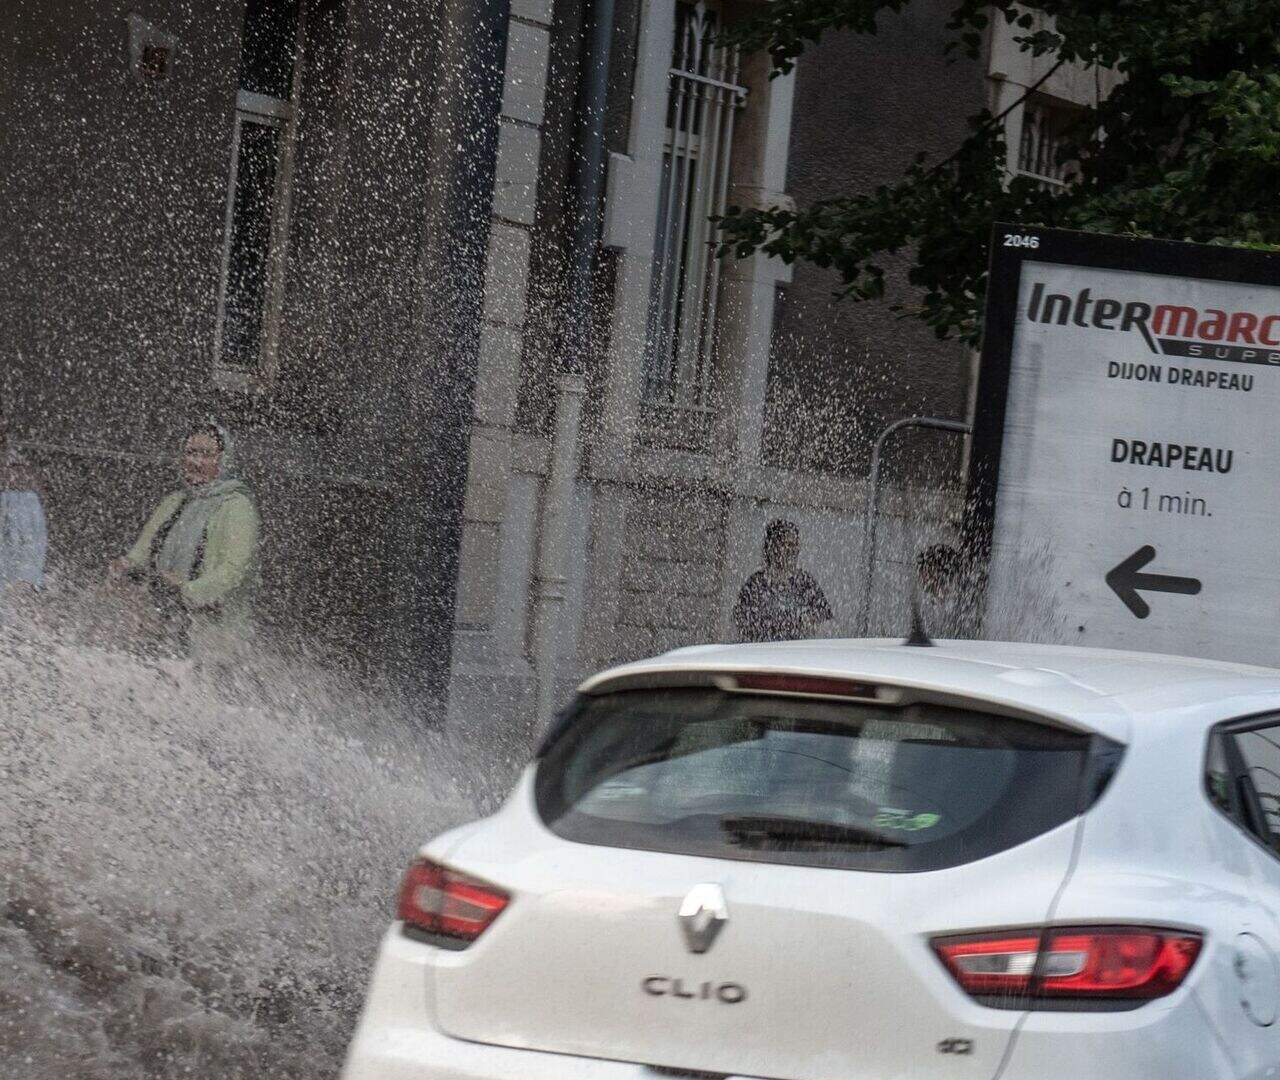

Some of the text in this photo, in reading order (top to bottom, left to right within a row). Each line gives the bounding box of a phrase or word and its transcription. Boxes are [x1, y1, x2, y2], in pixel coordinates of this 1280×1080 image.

[1003, 234, 1040, 249] 2046
[1107, 361, 1254, 392] DIJON DRAPEAU
[1110, 438, 1234, 474] DRAPEAU
[1117, 486, 1213, 517] à 1 min.
[641, 975, 747, 1004] CLIO
